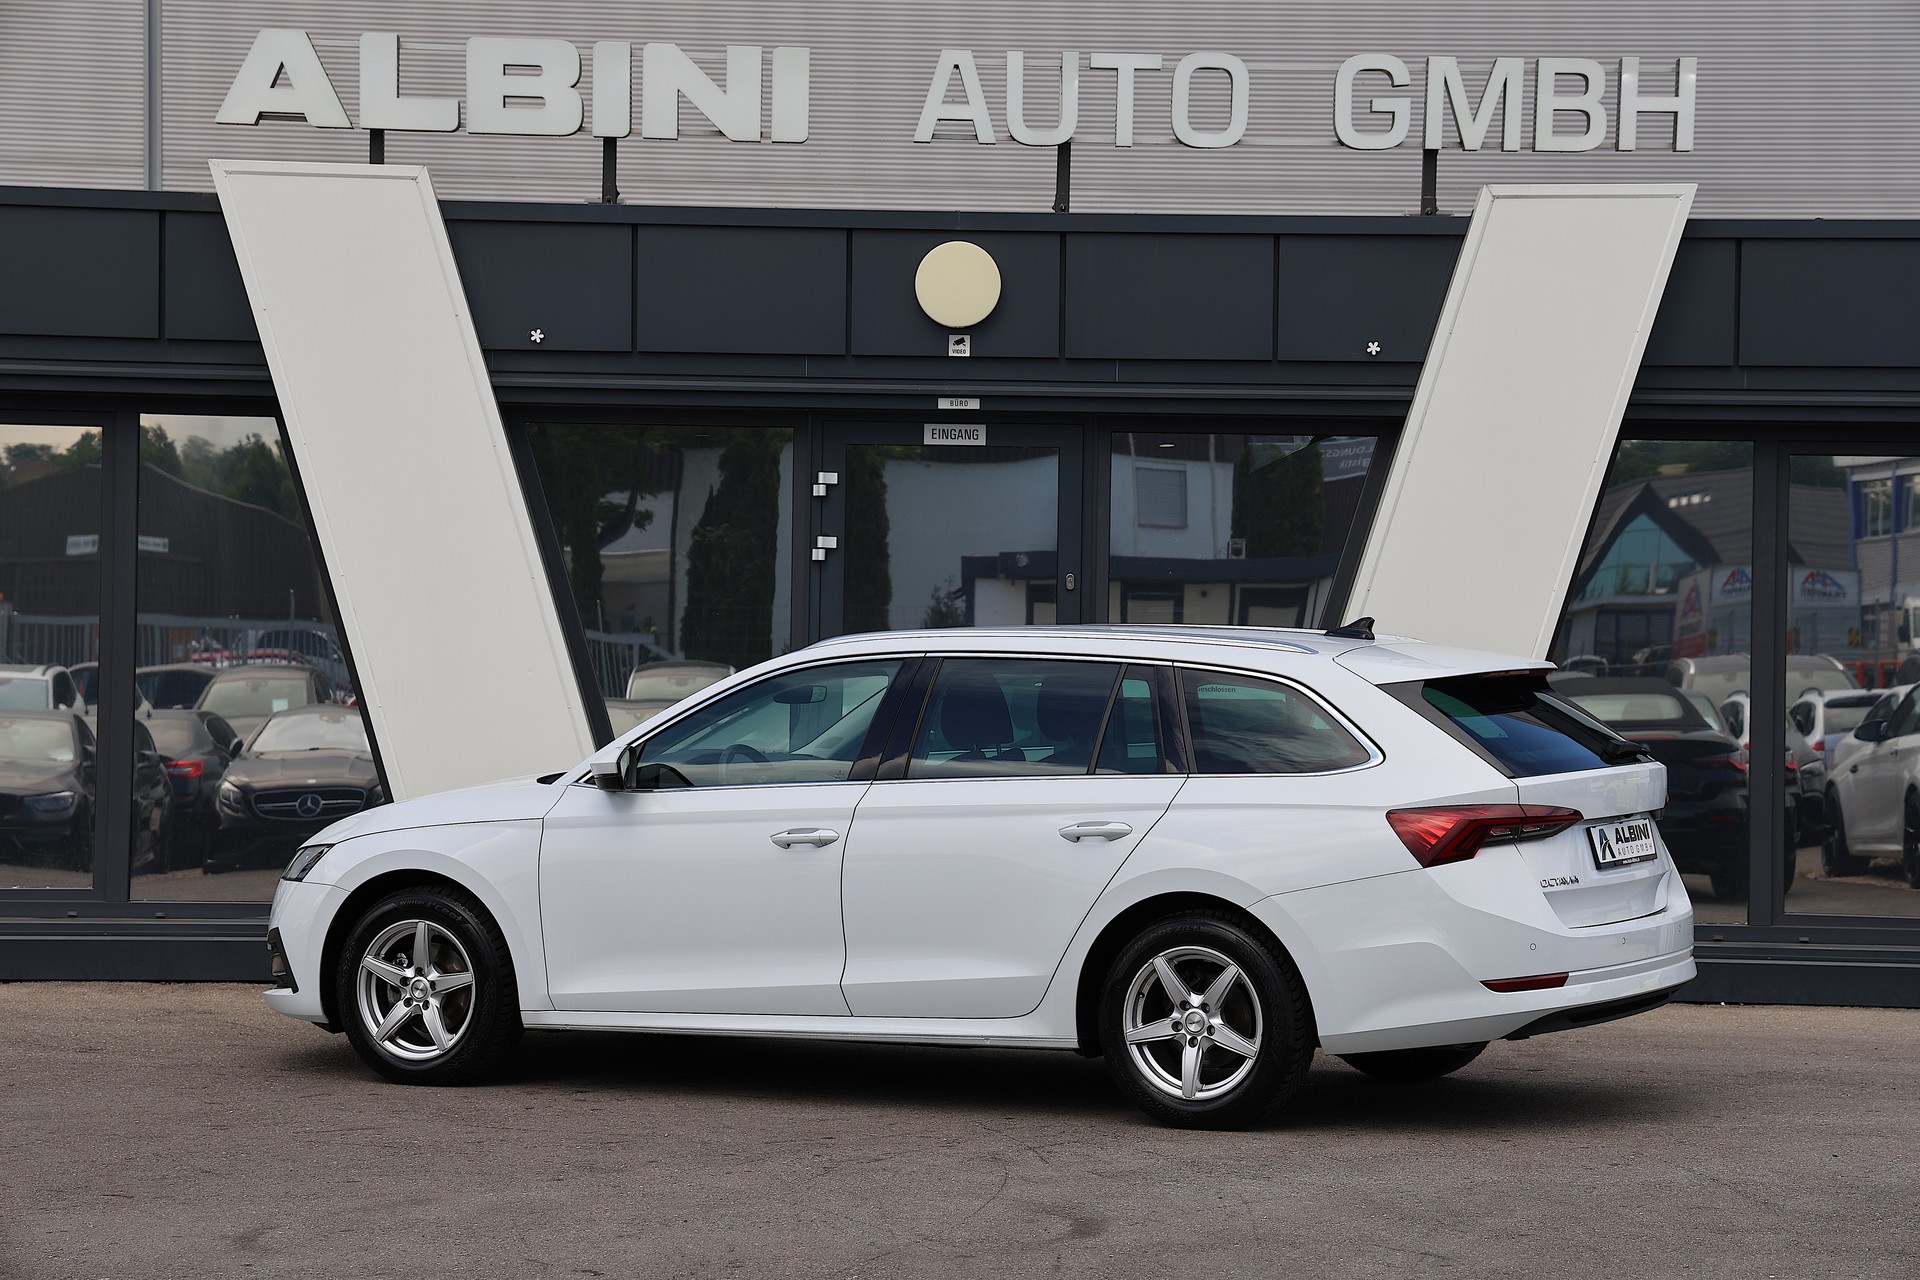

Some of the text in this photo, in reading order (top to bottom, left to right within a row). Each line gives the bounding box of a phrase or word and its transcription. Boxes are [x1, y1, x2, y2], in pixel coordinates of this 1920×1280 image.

[215, 28, 1698, 152] ALBINI AUTO GMBH
[949, 398, 969, 407] BÜRO
[931, 428, 979, 441] EINGANG
[1615, 823, 1650, 845] ALBINI
[1617, 842, 1653, 857] AUTO GMBH
